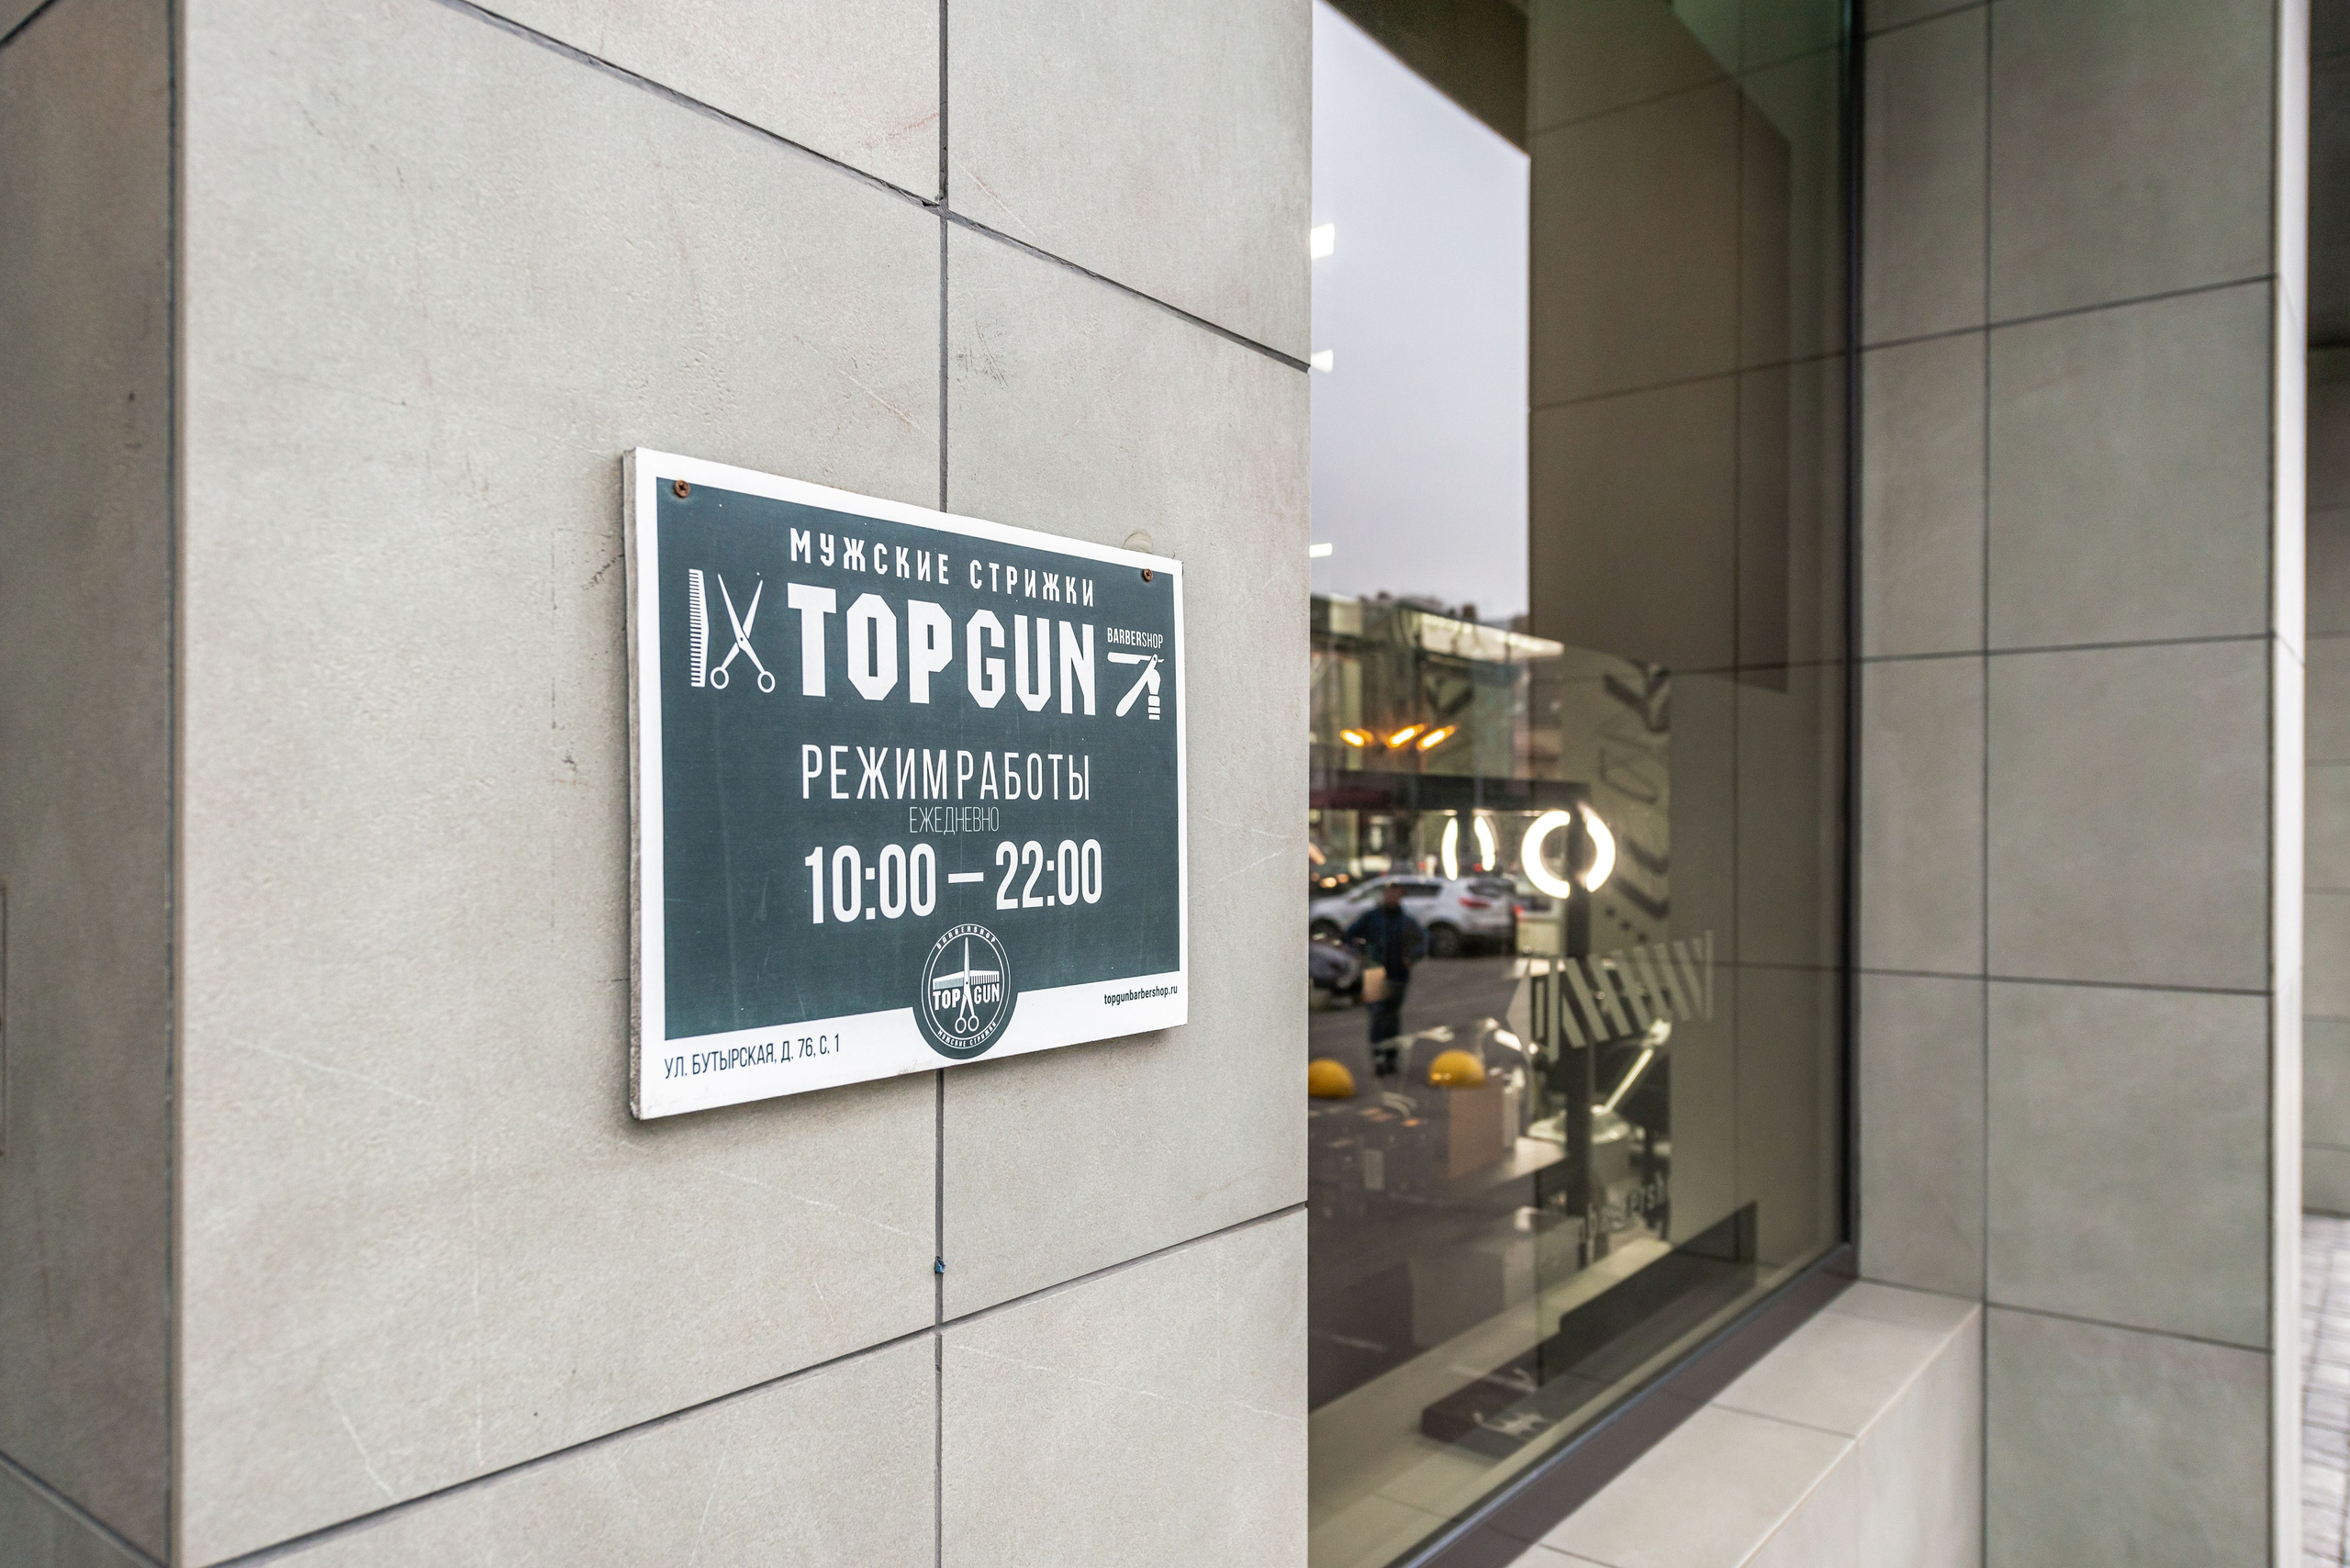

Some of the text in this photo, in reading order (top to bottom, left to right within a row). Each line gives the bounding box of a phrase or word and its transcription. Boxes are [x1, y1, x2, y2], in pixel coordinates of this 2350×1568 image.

[789, 527, 1093, 607] МУЖСКИЕ СТРИЖКИ
[1107, 627, 1164, 649] BARBERSHOP
[909, 806, 1000, 835] ЕЖЕДНЕВНО
[804, 843, 936, 924] 10:00
[995, 838, 1102, 910] 22:00
[936, 925, 997, 950] BARBERSHOP
[933, 982, 1000, 1011] TOP GUN
[1103, 985, 1178, 1006] topgunbarbershop.ru
[937, 1021, 997, 1047] МУЖСКИЕ СТРИЖКИ
[664, 1056, 688, 1080] УЛ.
[692, 1043, 777, 1075] БУТЫРСКАЯ,
[780, 1040, 794, 1064] Д.
[798, 1036, 816, 1058] 76,
[834, 1033, 840, 1052] 1
